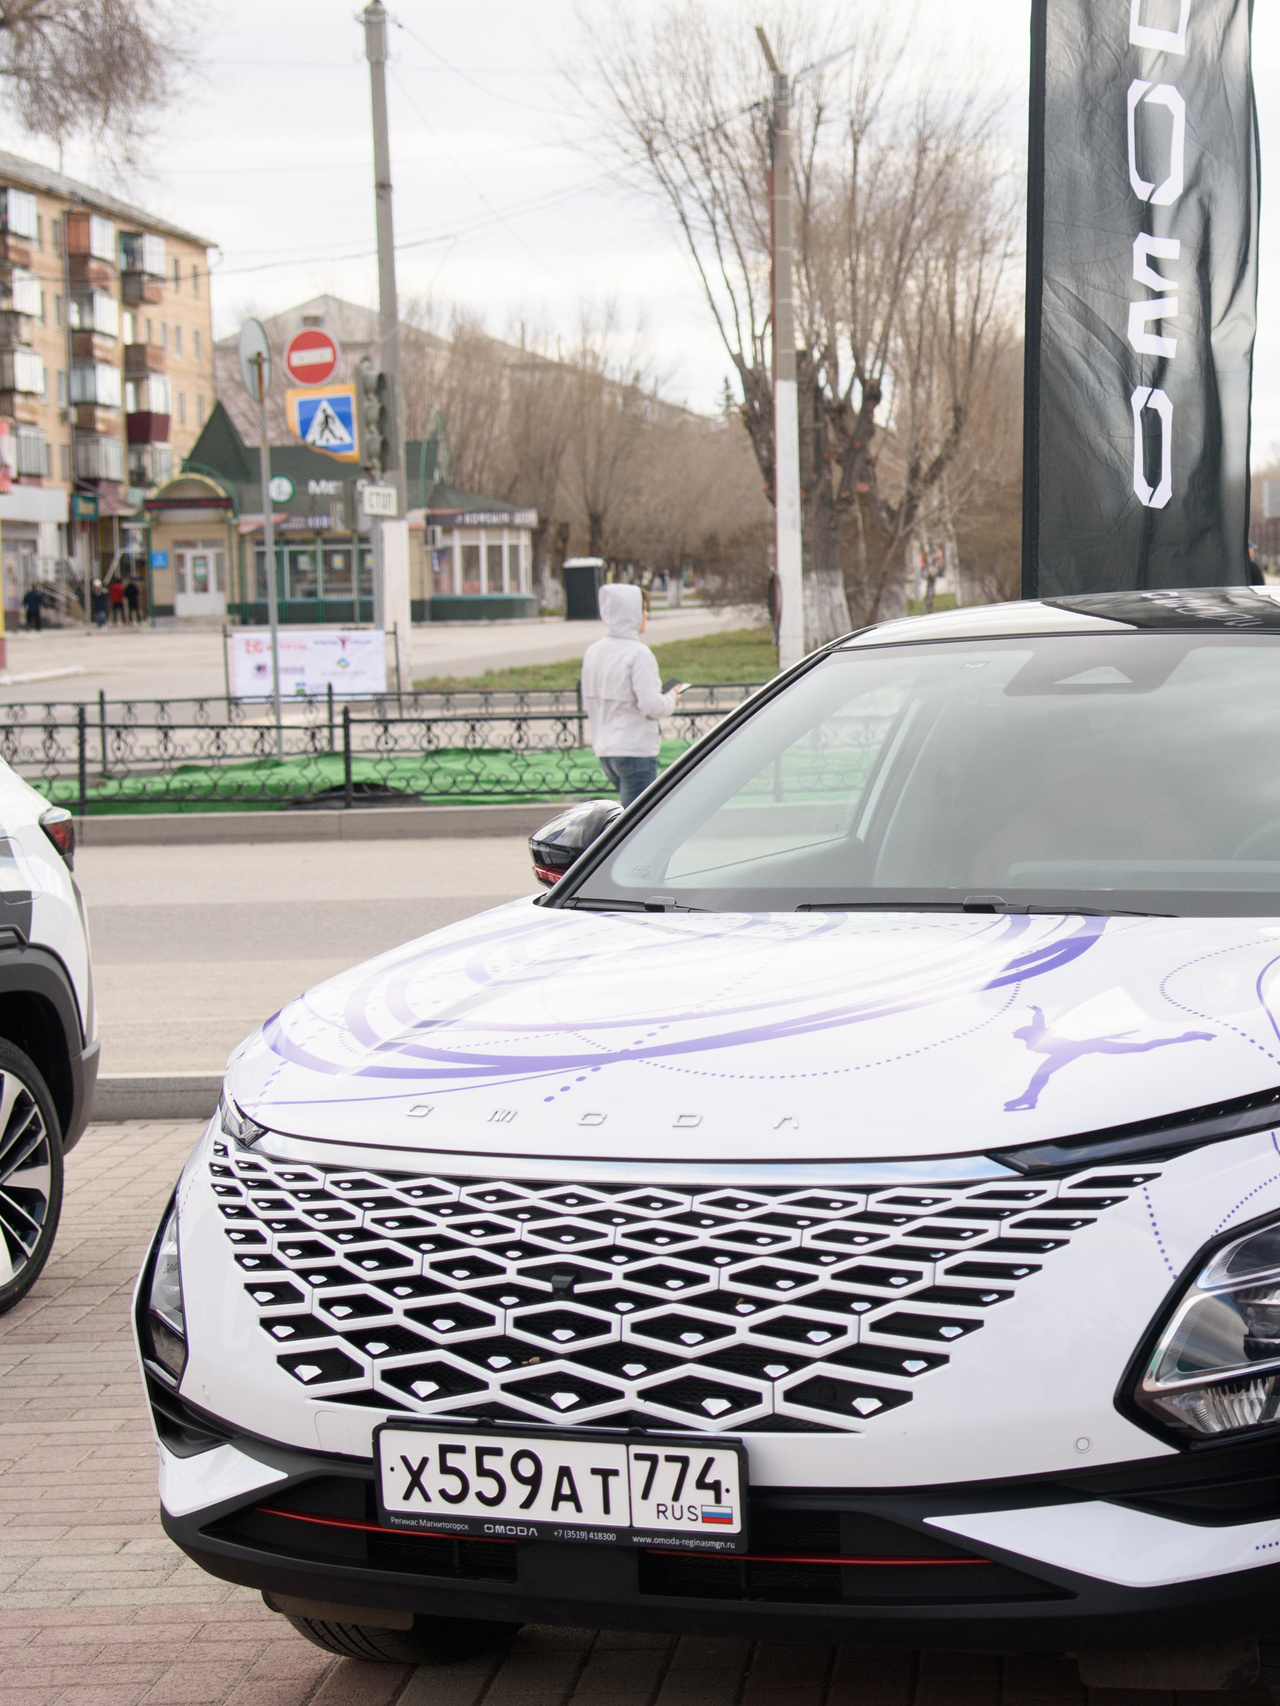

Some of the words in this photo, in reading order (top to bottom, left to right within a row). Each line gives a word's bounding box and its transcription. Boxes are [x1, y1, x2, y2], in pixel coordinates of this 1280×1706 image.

[632, 1452, 723, 1505] 774
[656, 1503, 699, 1522] RUS
[390, 1516, 418, 1527] Регинас
[419, 1519, 470, 1531] Магнитогорск
[484, 1523, 538, 1537] OMODA
[553, 1530, 562, 1538] +7
[564, 1530, 588, 1541] (3519)
[588, 1532, 617, 1542] 418300
[632, 1534, 736, 1549] www.omoda-reginasmgn.ru
